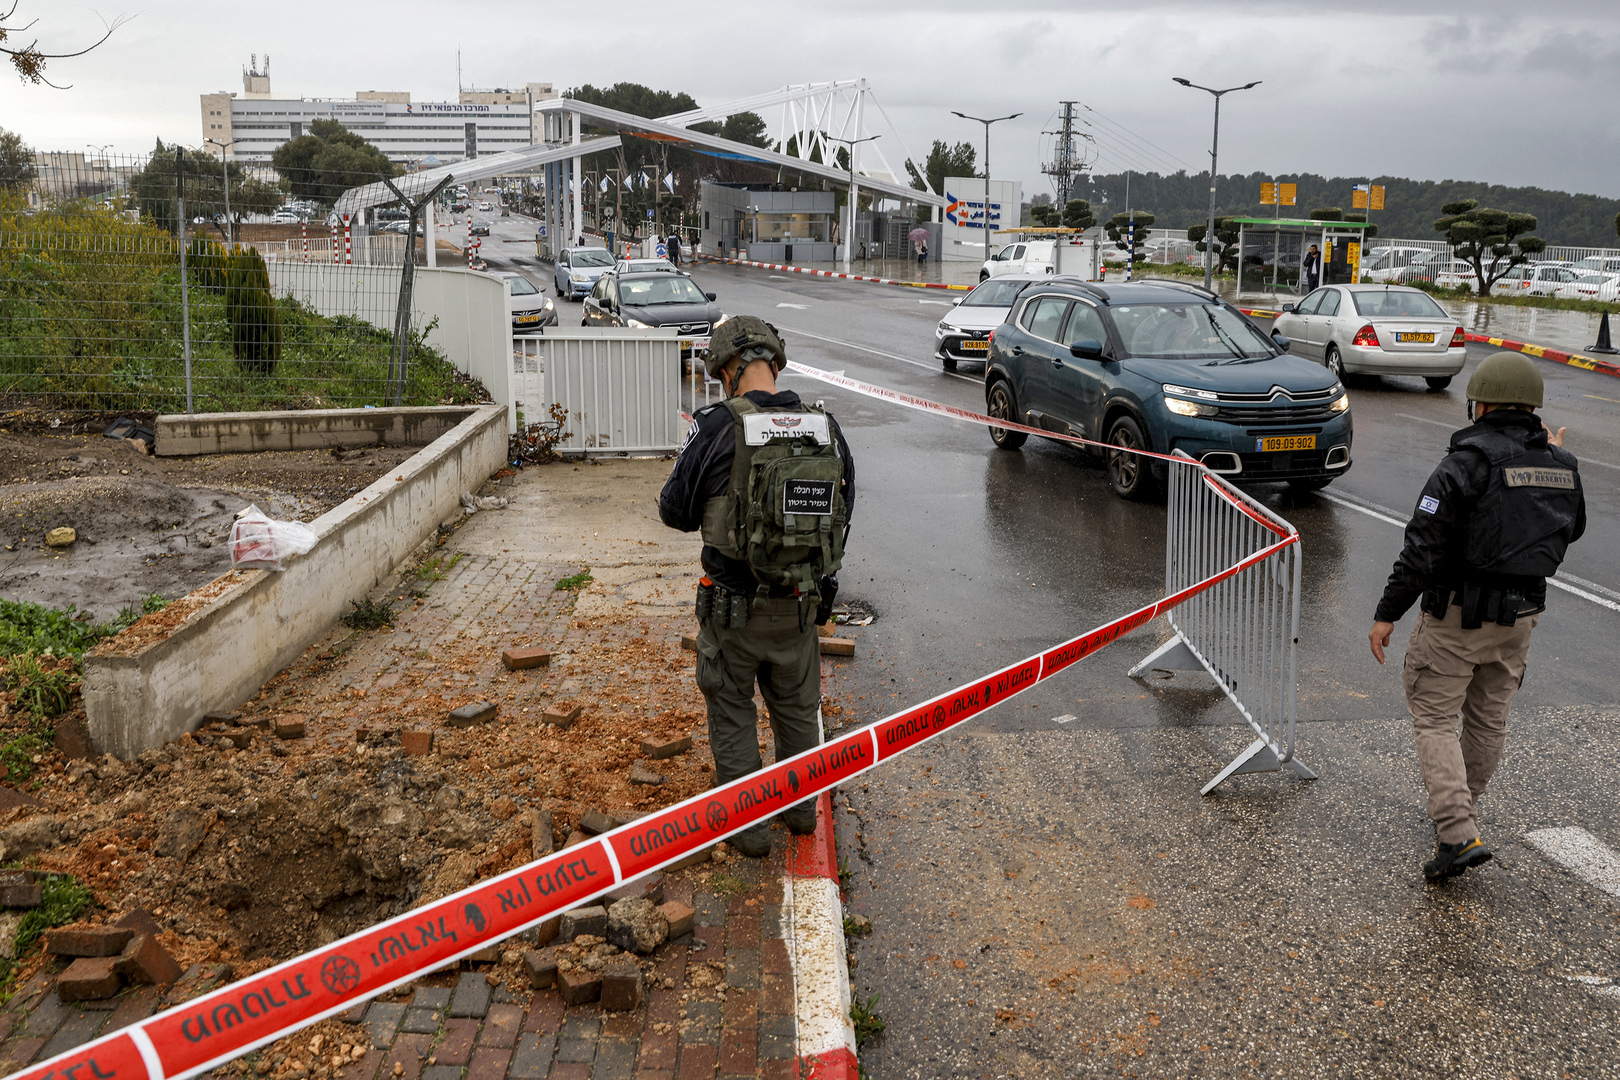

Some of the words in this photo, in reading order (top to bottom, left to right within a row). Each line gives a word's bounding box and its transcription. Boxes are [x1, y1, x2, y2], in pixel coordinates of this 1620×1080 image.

[793, 485, 811, 494] חבלה
[811, 487, 826, 496] קצין
[1535, 475, 1572, 483] RESERVES
[886, 712, 929, 745] משטרת
[950, 690, 979, 717] ישראל
[996, 677, 1009, 694] אין
[1011, 666, 1034, 687] מעבר
[629, 812, 702, 857] משטרת
[734, 779, 783, 814] ישראל
[806, 753, 827, 781] אין
[830, 741, 866, 771] מעבר
[181, 973, 312, 1043] משטרת
[370, 915, 459, 968] ישראל
[496, 877, 532, 915] אין
[536, 858, 597, 896] מעבר
